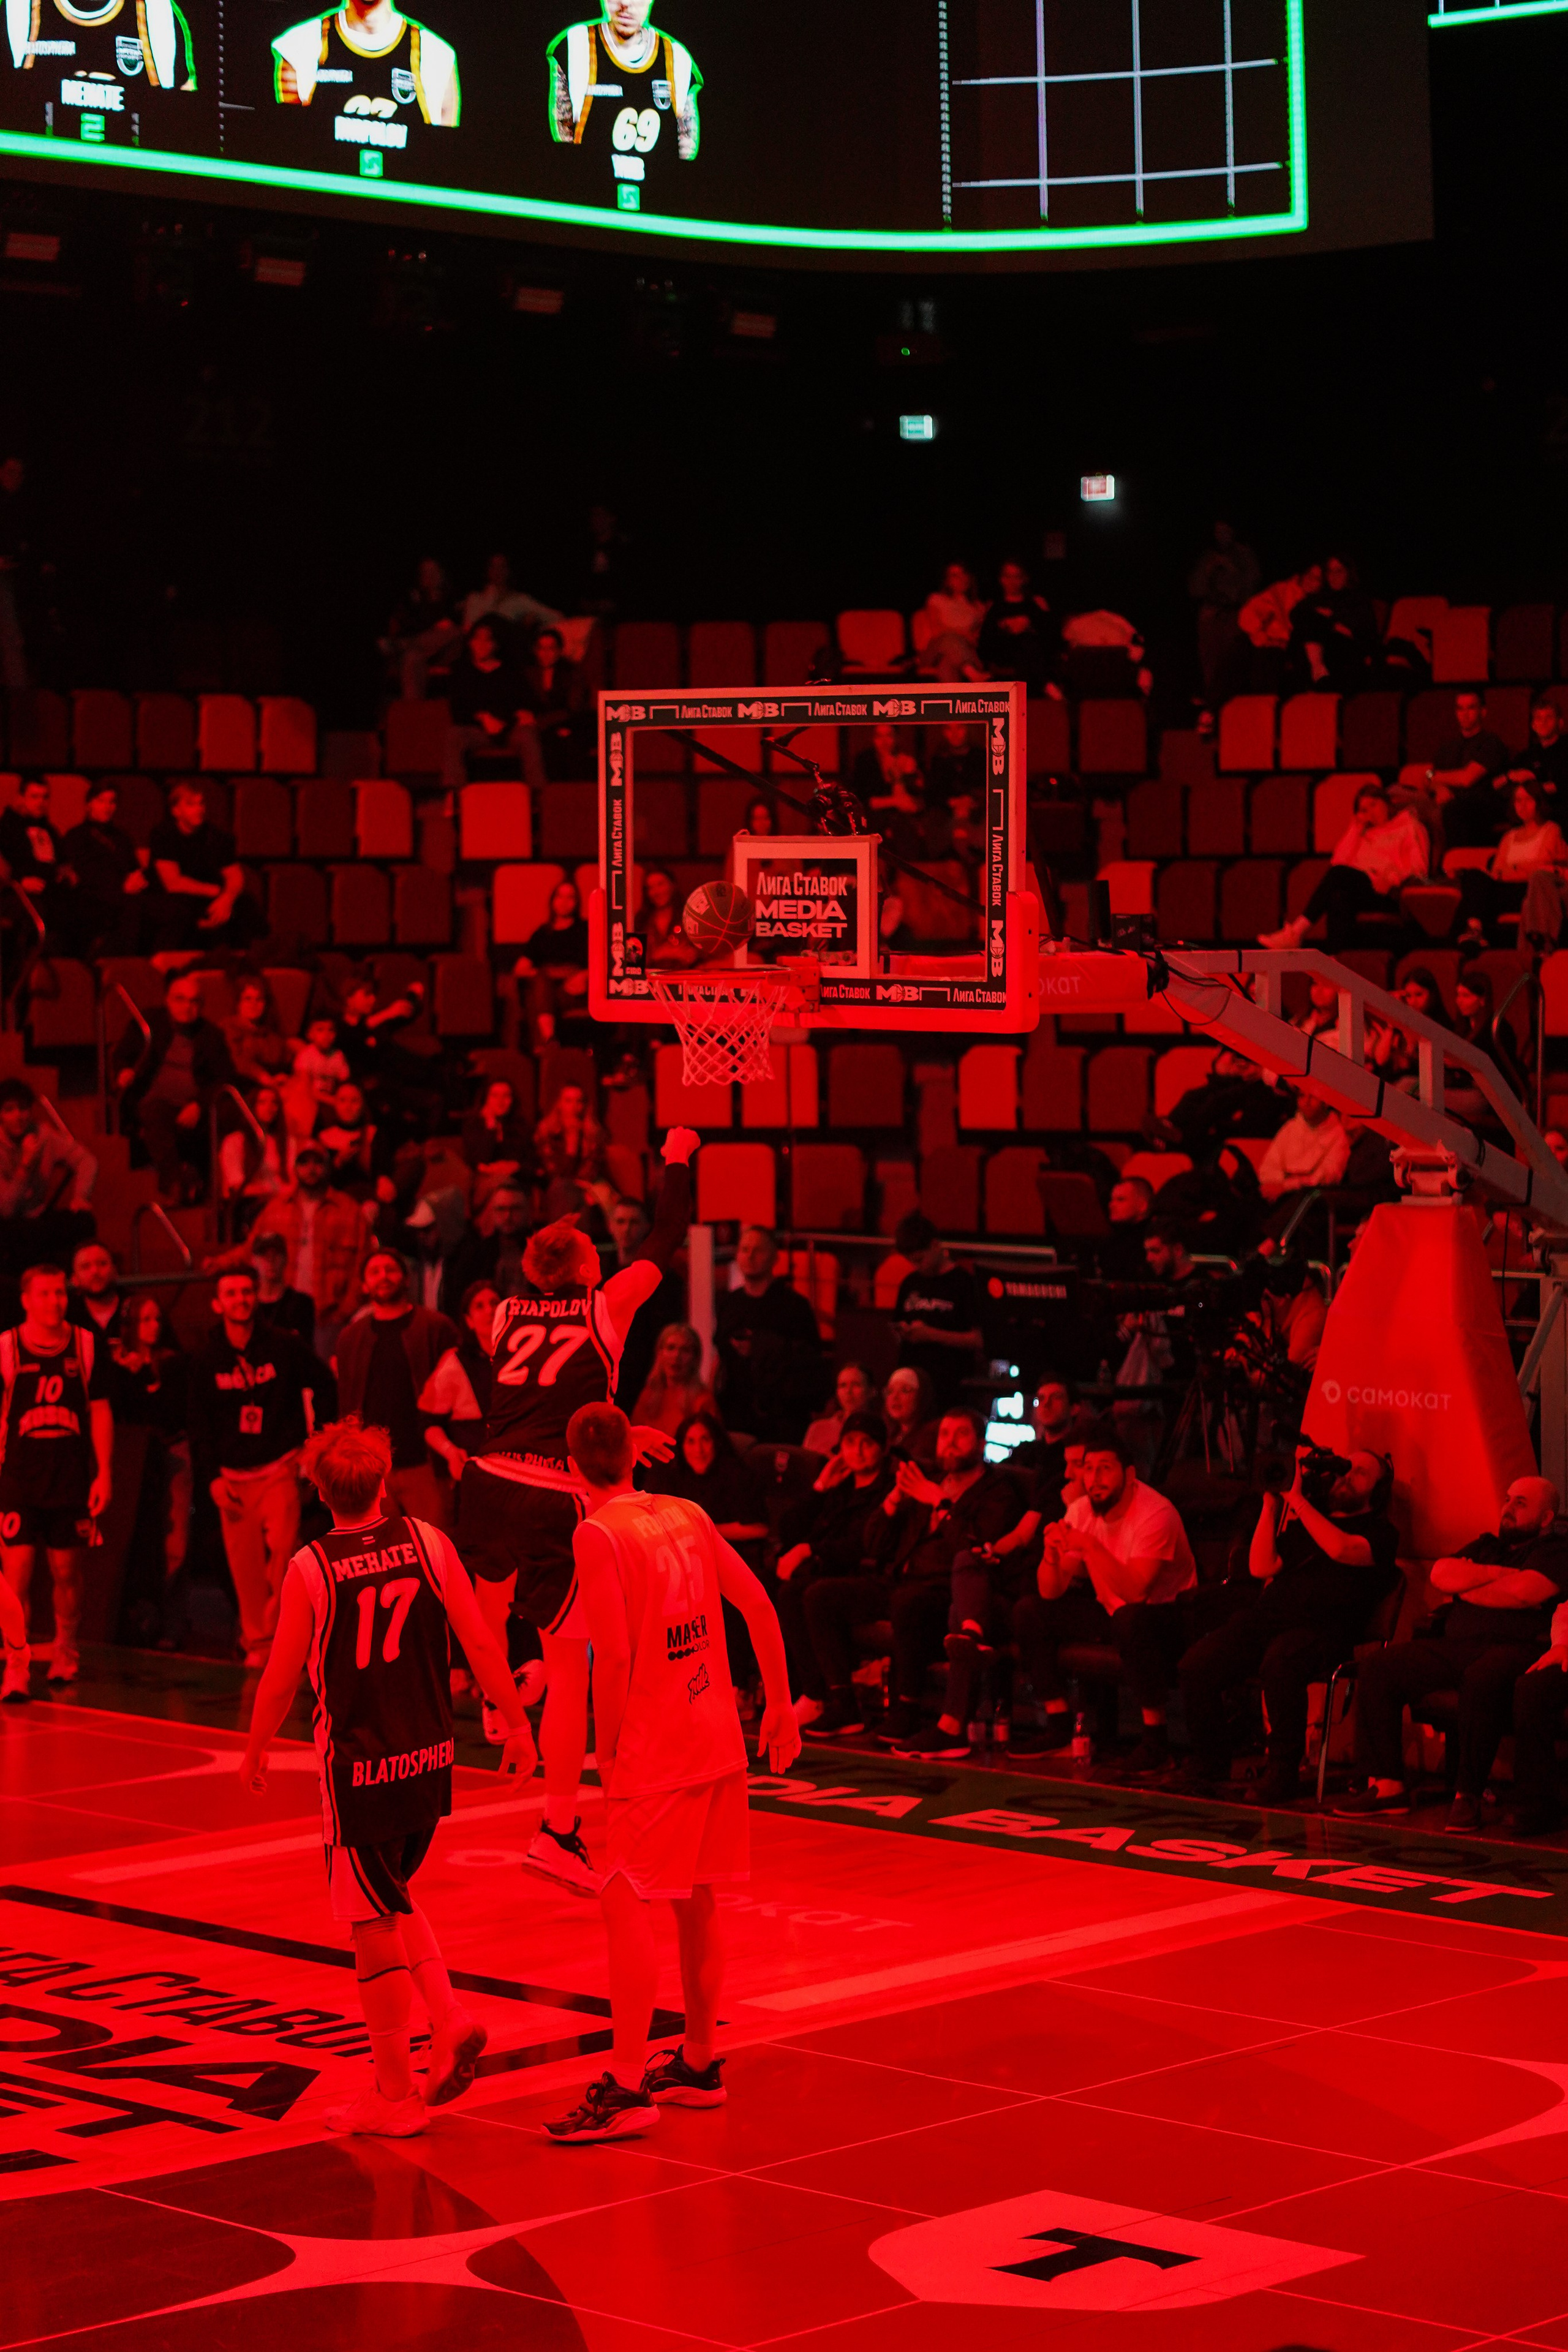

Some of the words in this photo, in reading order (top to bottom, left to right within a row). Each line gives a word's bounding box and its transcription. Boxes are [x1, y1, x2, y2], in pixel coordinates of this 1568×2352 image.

[612, 107, 660, 153] 69
[756, 872, 792, 895] ЛИГА
[793, 872, 848, 896] СТАВОК
[755, 899, 847, 920] MEDIA
[755, 921, 848, 938] BASKET
[497, 1324, 591, 1386] 27
[35, 1374, 63, 1403] 10
[331, 1543, 418, 1582] MEHATE
[656, 1536, 704, 1618] 25
[356, 1577, 421, 1670] 17
[748, 1774, 922, 1819] DIA
[927, 1808, 1555, 1904] BASKET
